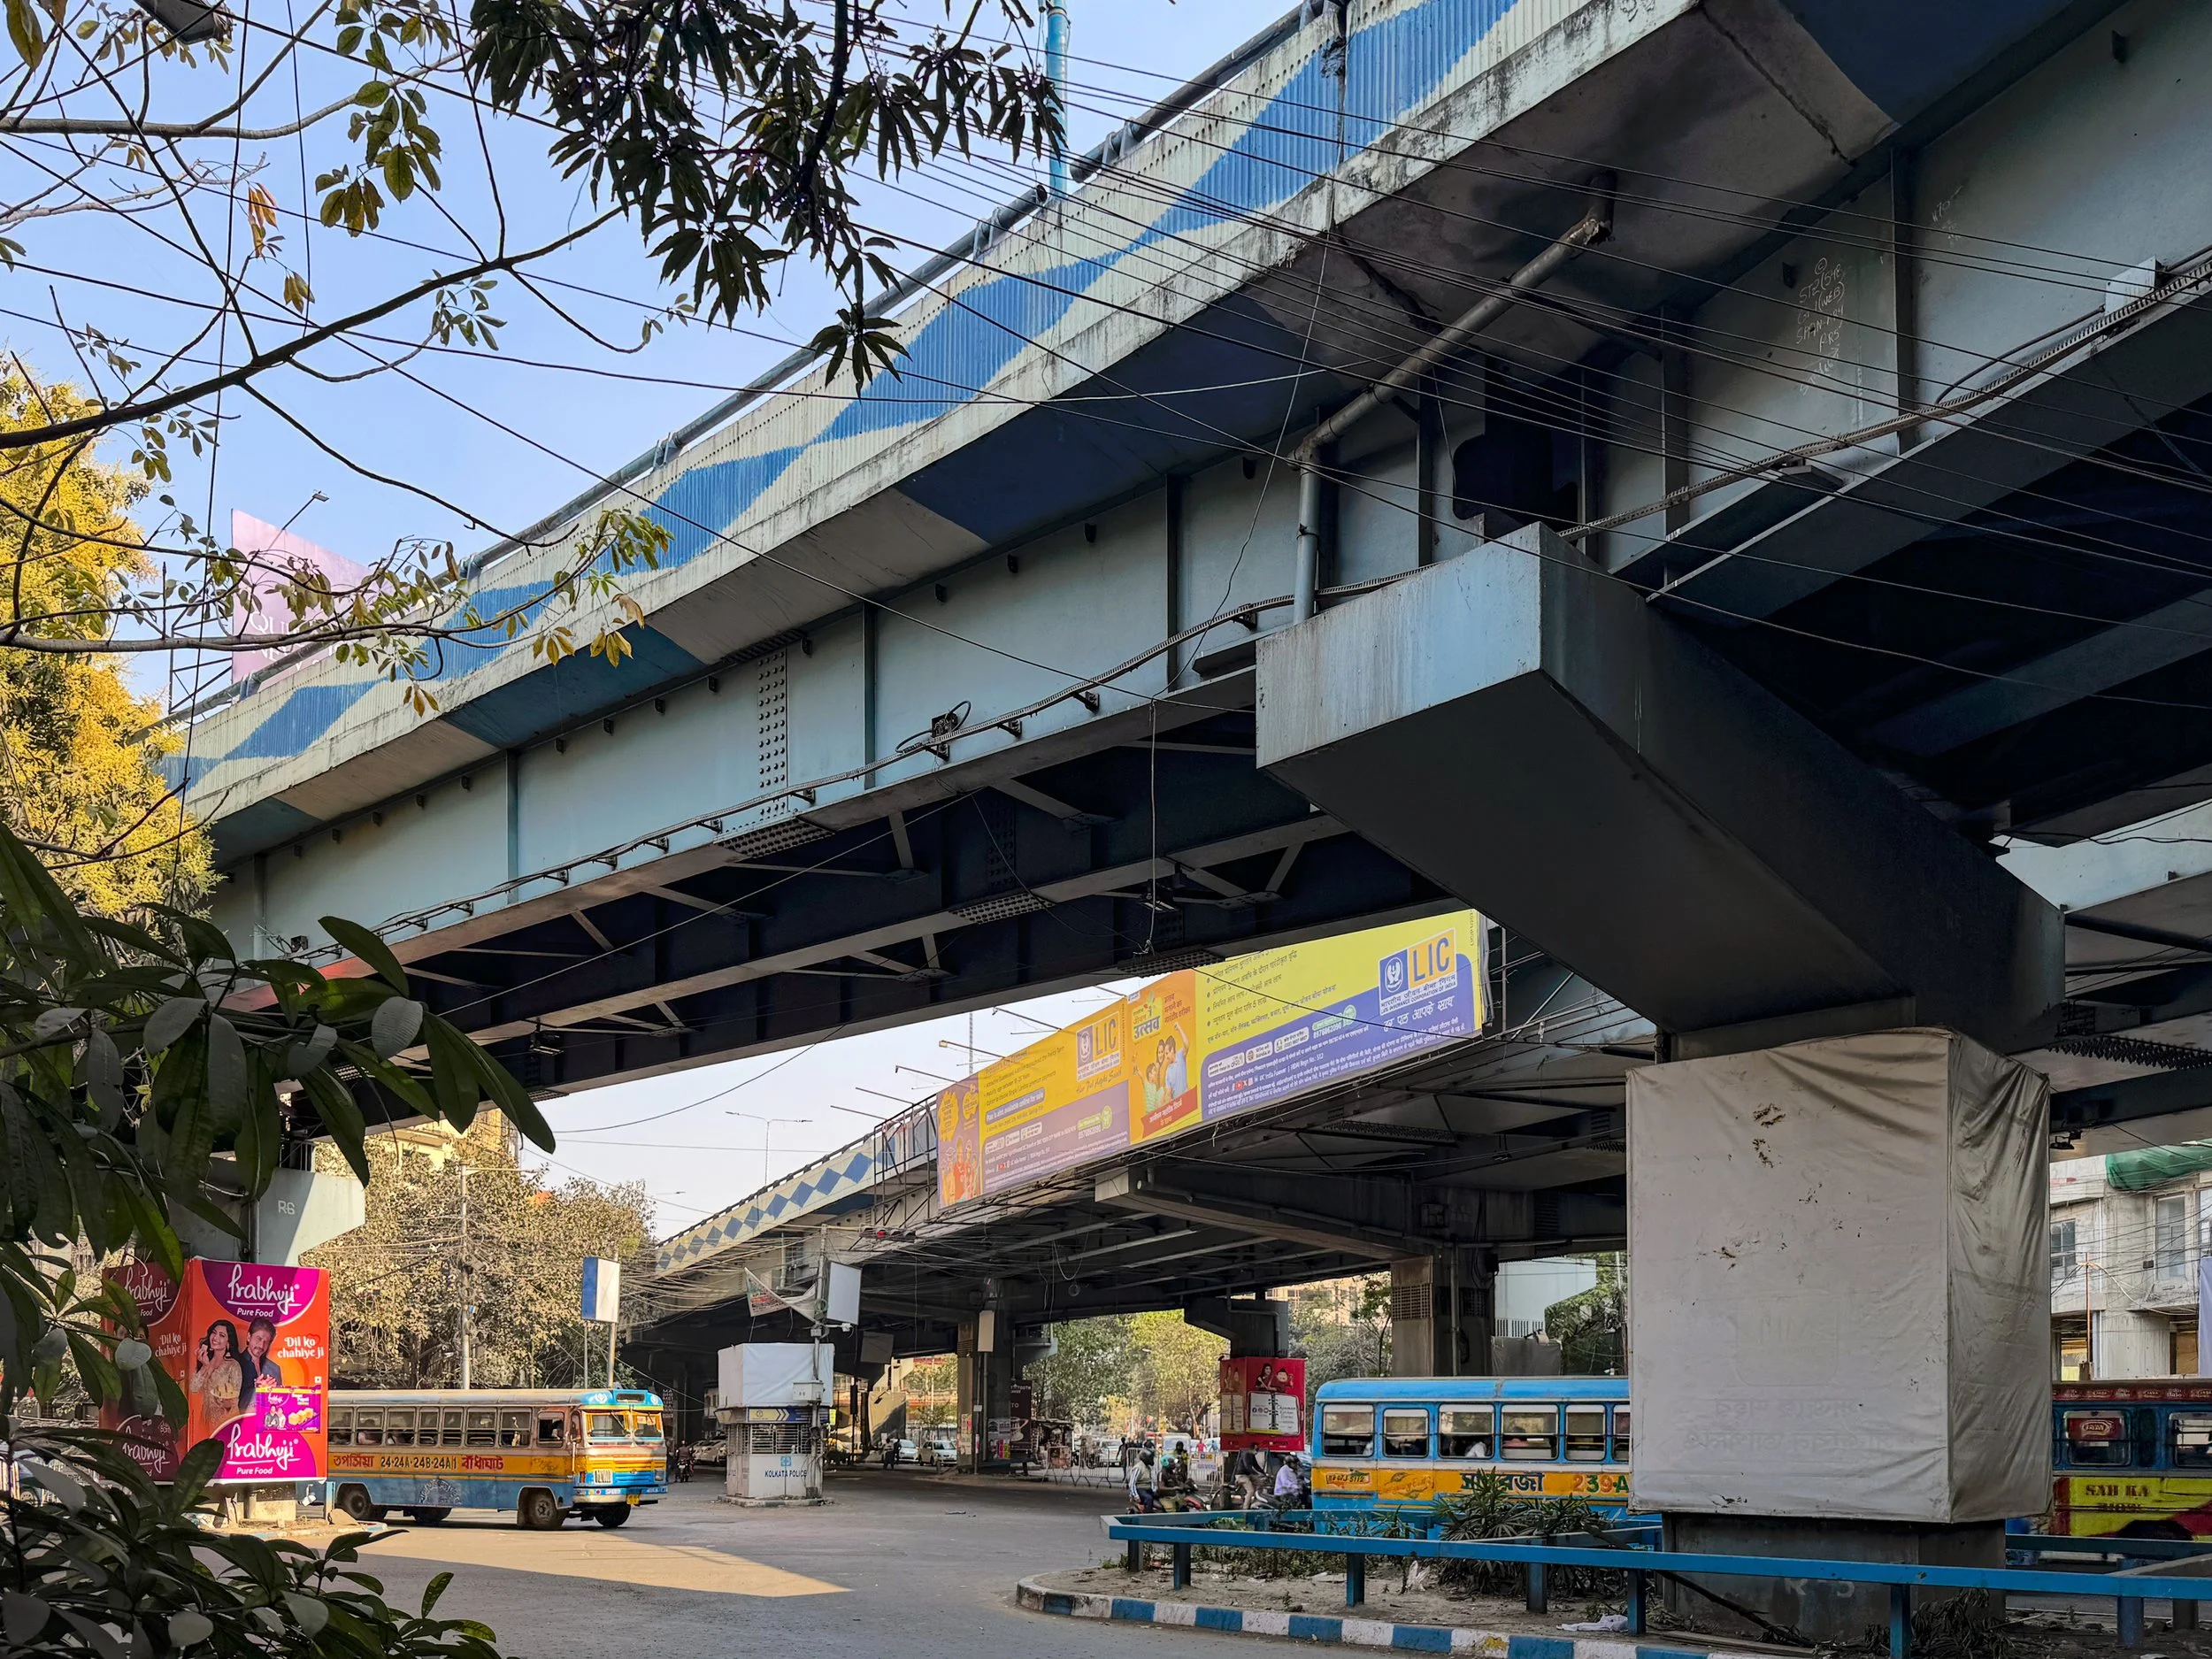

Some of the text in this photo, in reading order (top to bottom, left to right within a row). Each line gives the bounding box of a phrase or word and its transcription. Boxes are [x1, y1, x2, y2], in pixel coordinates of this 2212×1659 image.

[1412, 937, 1449, 982] LIC
[1411, 1000, 1434, 1020] आपके
[1096, 1019, 1116, 1055] LIC
[1133, 1015, 1160, 1039] उत्सव
[227, 1264, 296, 1316] Prabhuji
[255, 1309, 273, 1317] Food
[277, 1346, 325, 1360] chahiye ji
[284, 1336, 316, 1348] Dil ko
[227, 1424, 295, 1471] Prabhuji
